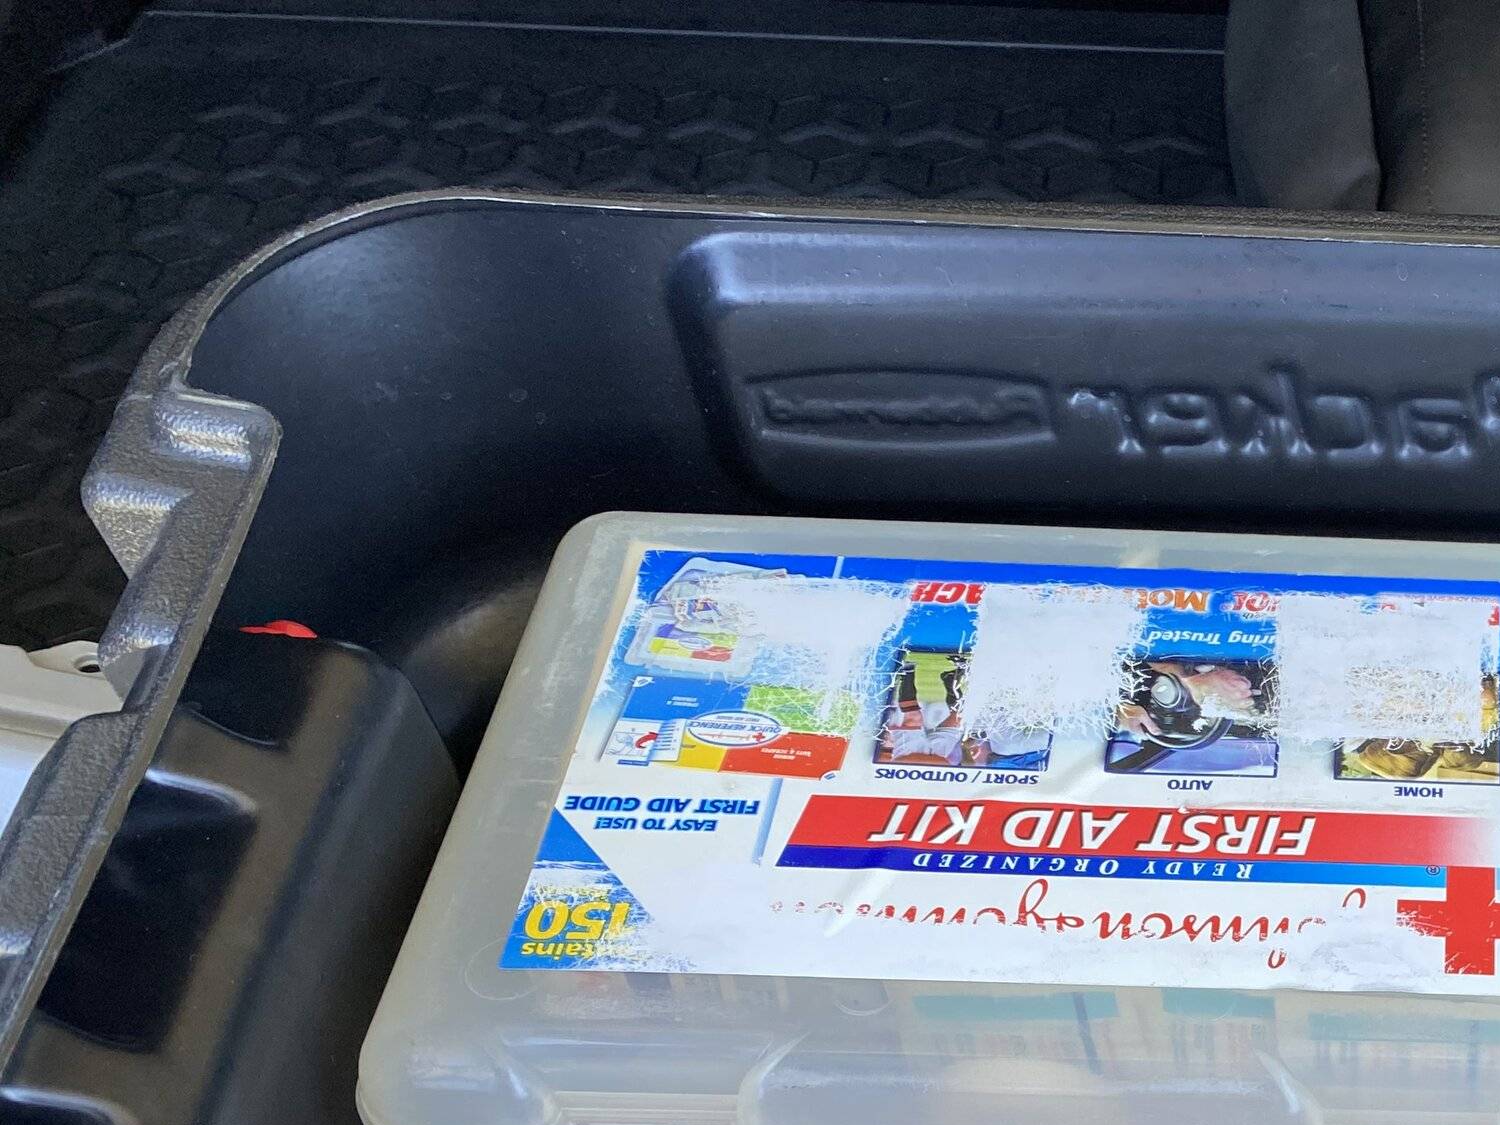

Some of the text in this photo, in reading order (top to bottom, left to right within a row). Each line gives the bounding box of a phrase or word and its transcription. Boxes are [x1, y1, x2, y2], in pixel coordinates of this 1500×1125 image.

[1149, 631, 1221, 645] Trusted
[874, 767, 968, 783] OUTDOORS
[982, 770, 1041, 785] SPORT
[1166, 779, 1213, 792] AUTO
[1393, 784, 1444, 798] HOME
[562, 796, 760, 815] FIRST AID GUIDE
[593, 817, 718, 832] EASY TO USE!
[867, 804, 1317, 857] FIRST AID KIT
[913, 852, 1254, 880] READY ORGANIZED
[525, 900, 634, 940] 150
